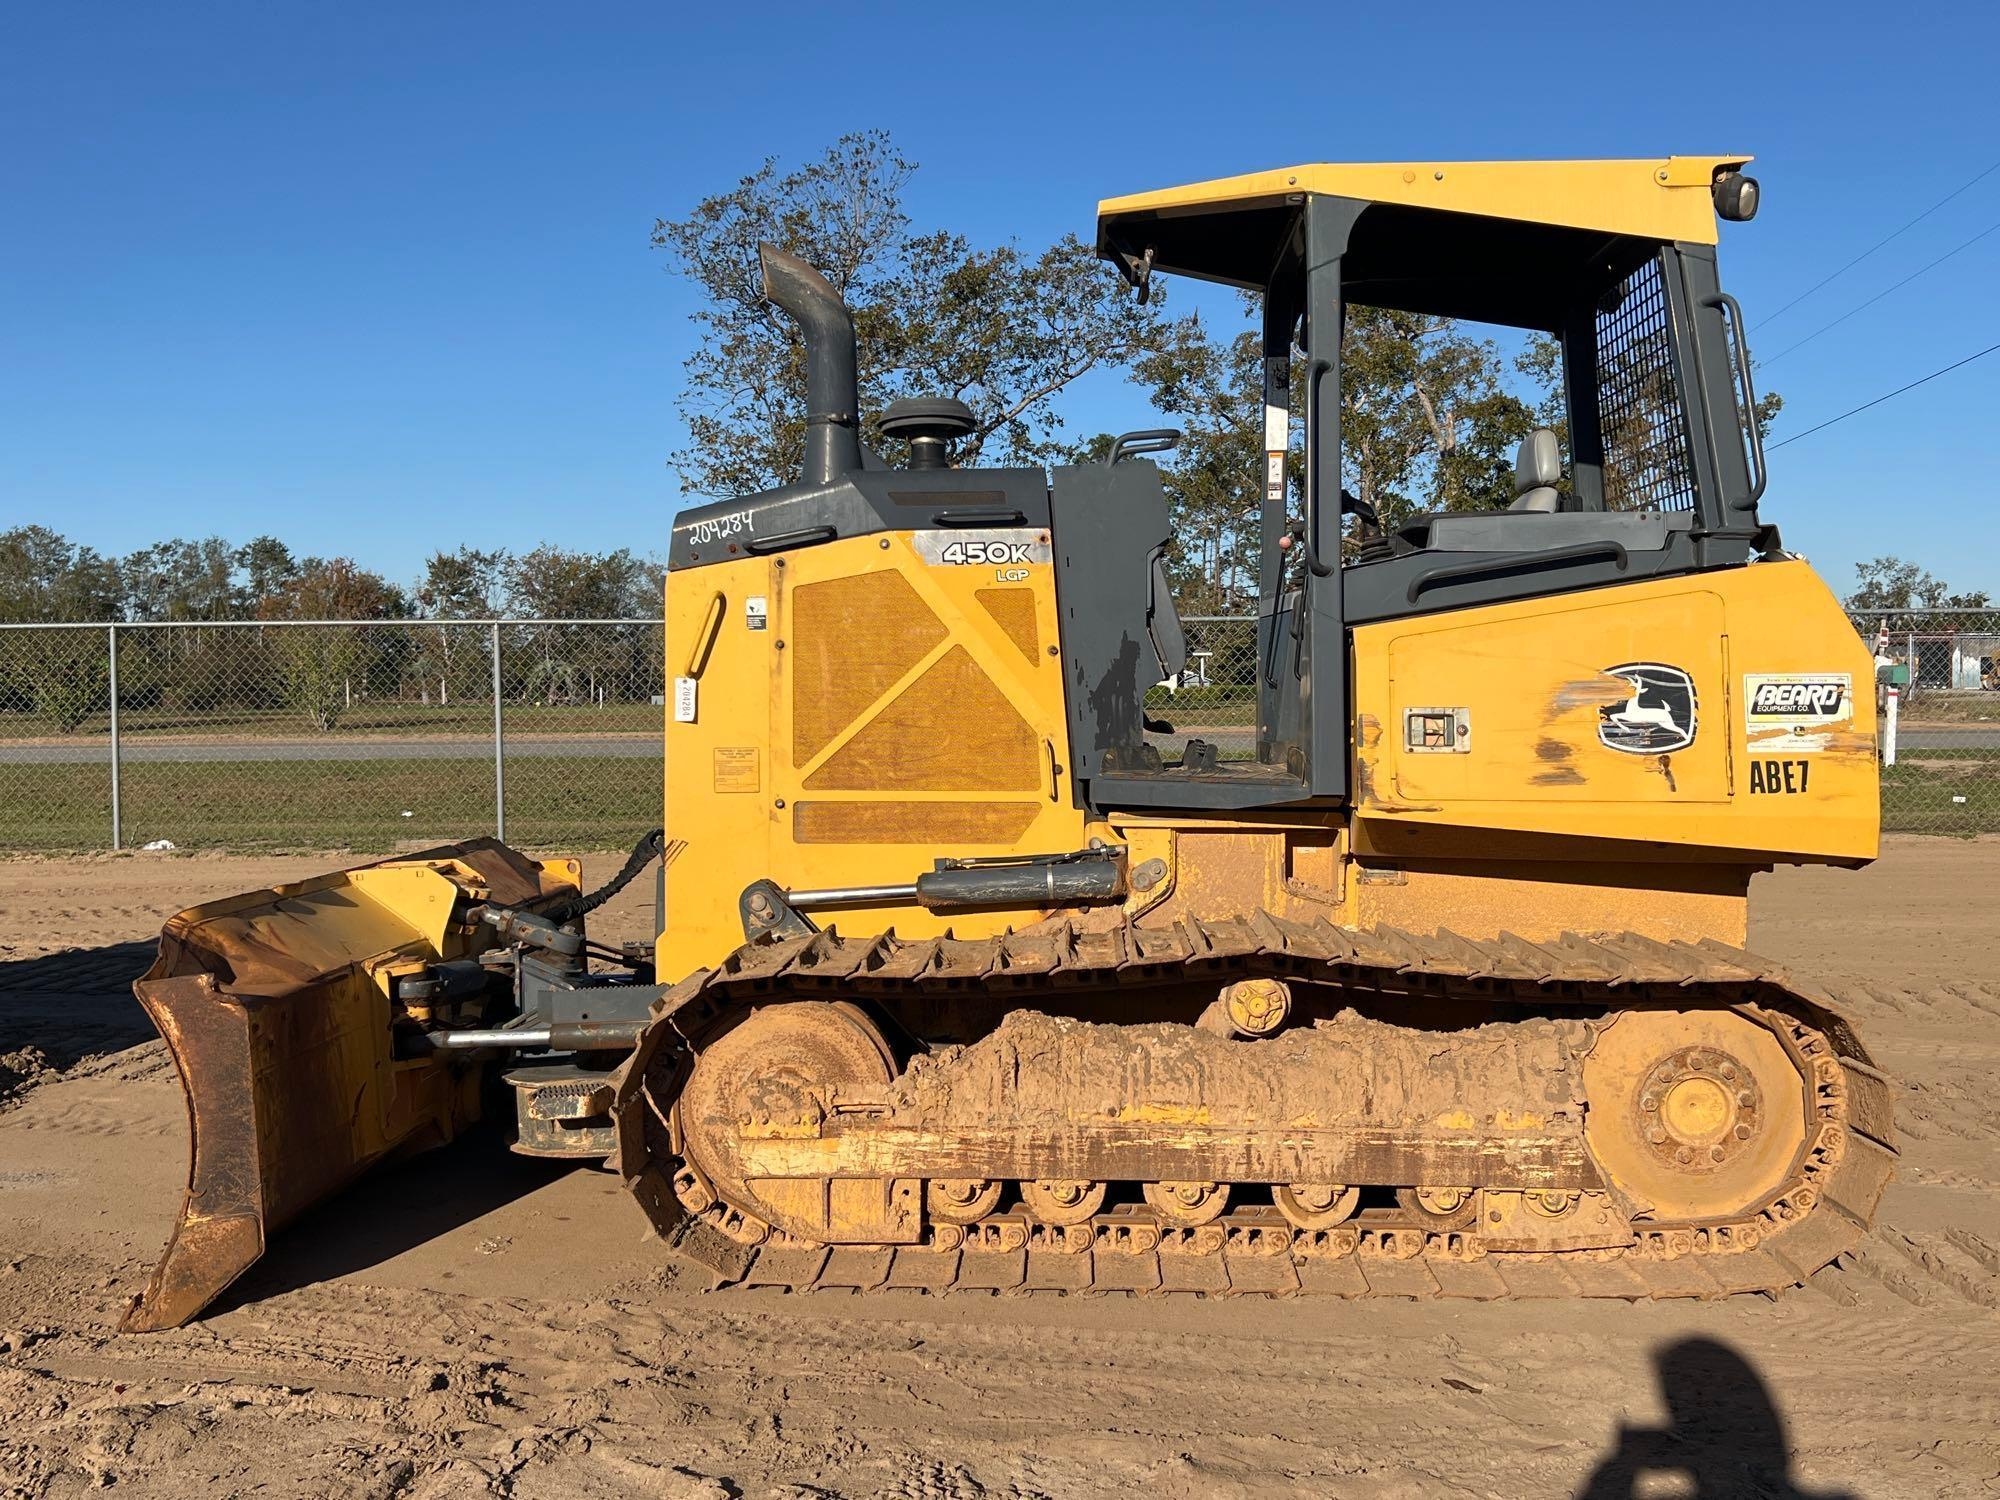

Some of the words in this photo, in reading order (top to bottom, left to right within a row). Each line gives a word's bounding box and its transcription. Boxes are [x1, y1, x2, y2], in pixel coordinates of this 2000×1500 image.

[689, 509, 754, 545] 204284
[942, 541, 1034, 565] 450K
[996, 569, 1030, 582] LGP
[1755, 684, 1838, 715] BEARD
[1750, 760, 1809, 794] ABE7
